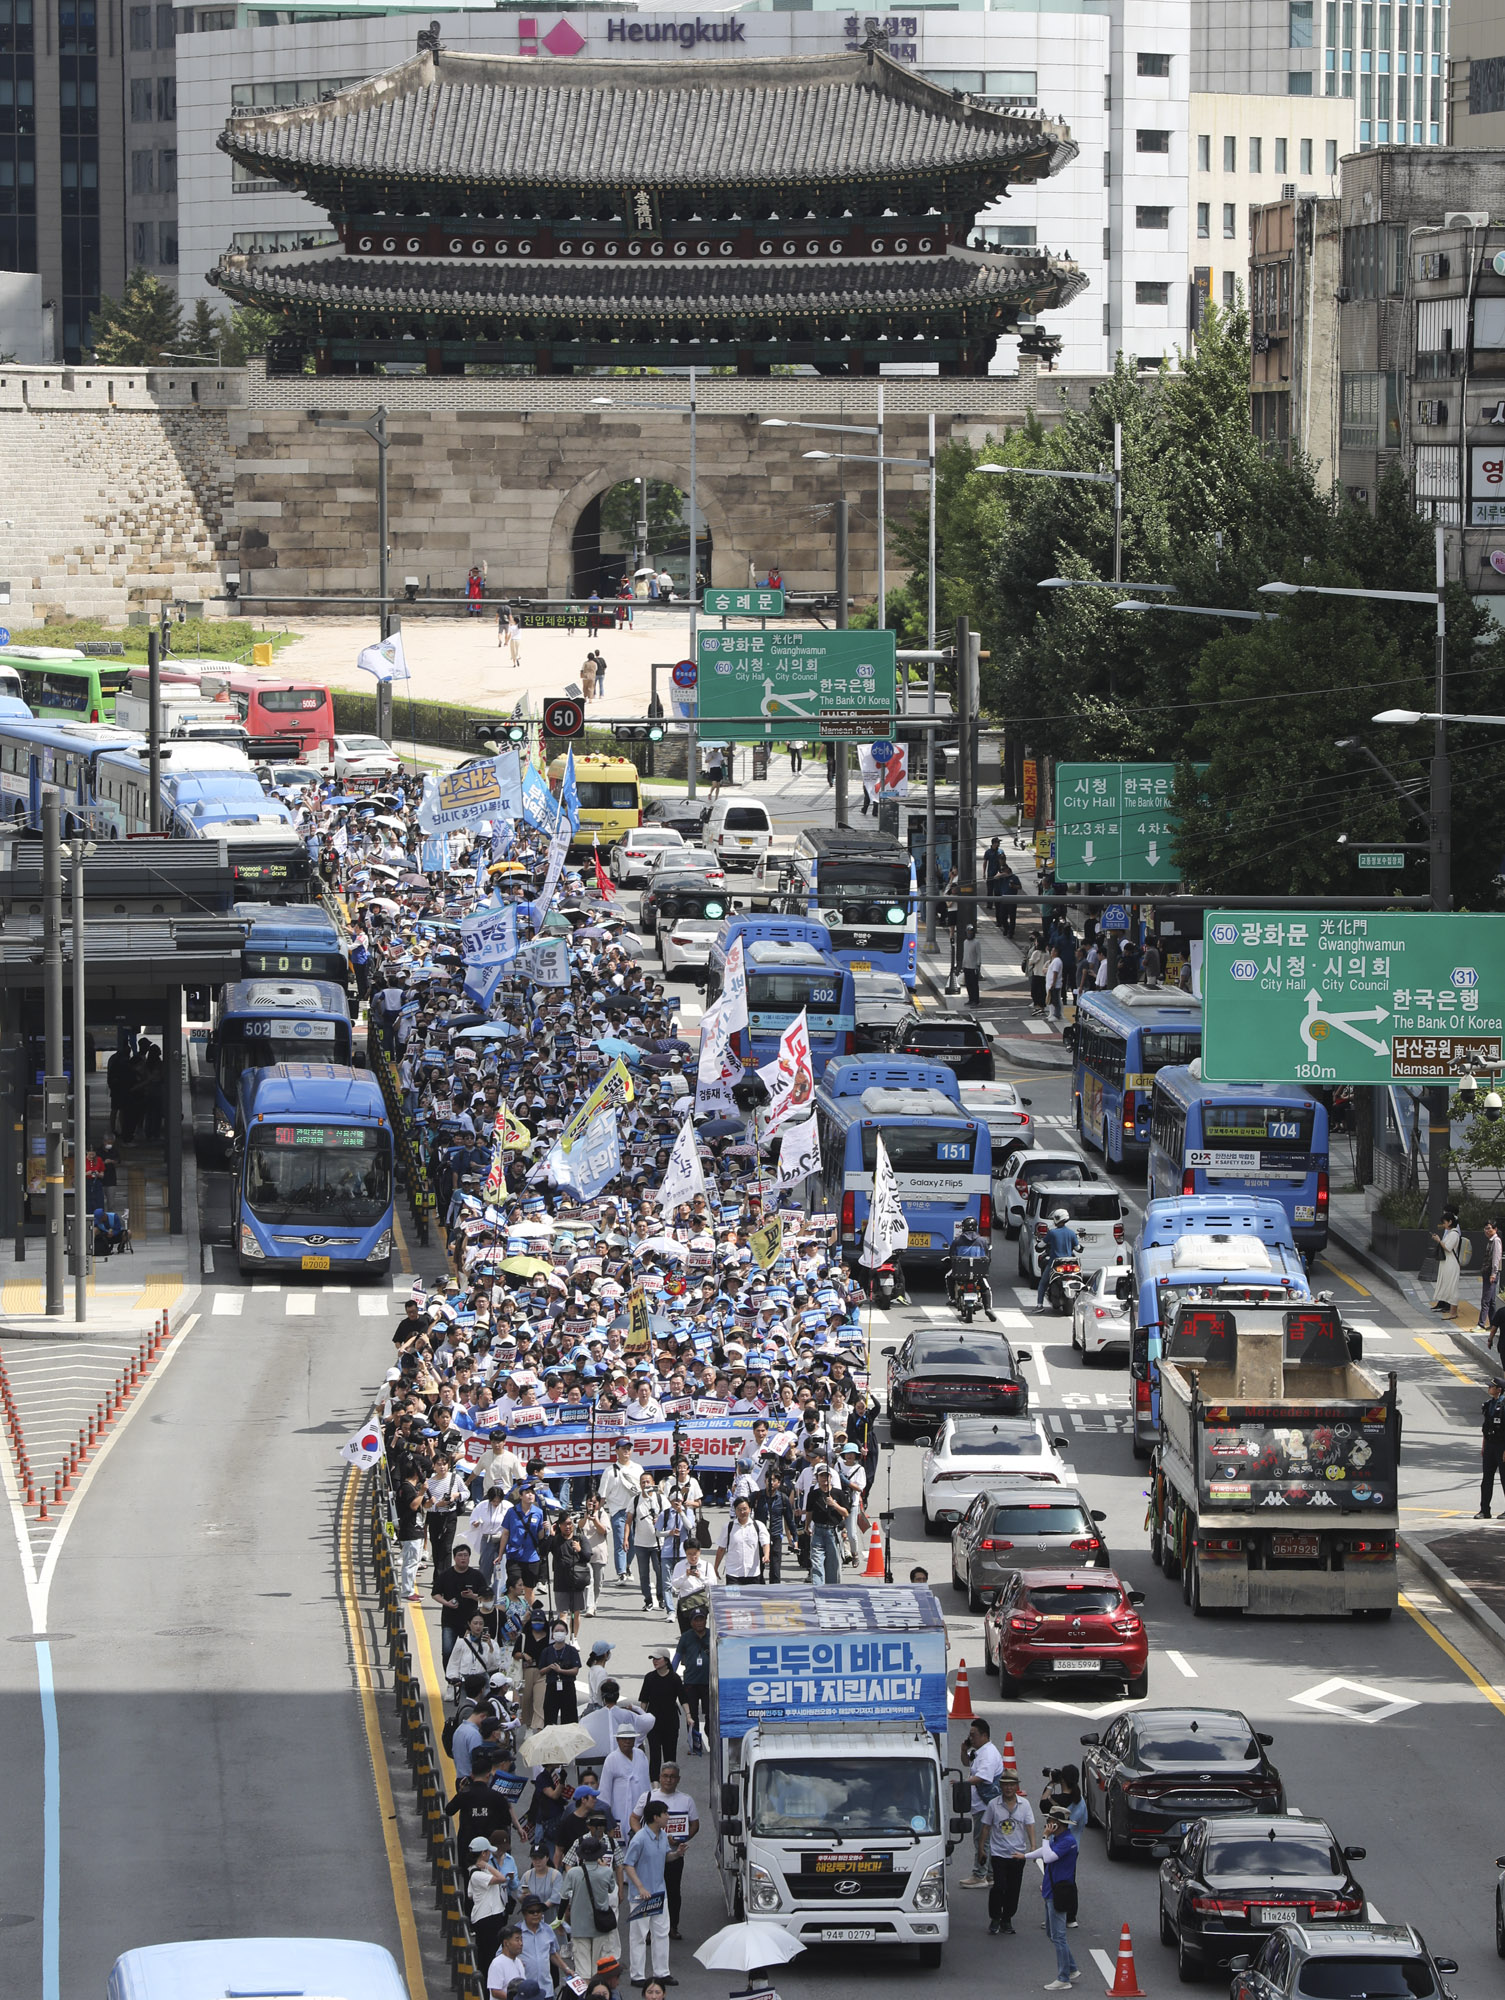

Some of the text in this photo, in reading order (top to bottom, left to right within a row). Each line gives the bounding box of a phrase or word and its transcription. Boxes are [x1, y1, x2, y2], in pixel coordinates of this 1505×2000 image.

[607, 17, 746, 48] Heungkuk
[715, 594, 773, 611] 숭례문
[523, 615, 588, 628] 진입제한차량
[705, 636, 765, 653] 50 광화문
[772, 634, 803, 646] 光化門
[771, 646, 827, 657] Gwanghwamun
[718, 658, 818, 673] 60 시청 시의회
[858, 666, 872, 677] 31
[735, 672, 765, 682] City Hall
[775, 672, 818, 682] City Council
[820, 678, 876, 693] 한국은행
[302, 700, 317, 708] 5005
[820, 696, 890, 705] The Bank Of Korea
[553, 710, 574, 727] 50
[1074, 778, 1107, 794] 시청
[1064, 797, 1116, 810] City Hall
[1124, 797, 1137, 808] The
[1137, 797, 1154, 808] Bank
[1155, 797, 1164, 808] Of
[1216, 922, 1309, 947] 50 광화문
[1320, 919, 1368, 936] 光化門
[1318, 937, 1406, 954] Gwanghwamun
[259, 956, 312, 971] 100
[1236, 955, 1391, 978] 60 시청 시의회
[1456, 970, 1473, 984] 31
[1260, 979, 1306, 992] City Hall
[1322, 979, 1389, 992] City Council
[812, 989, 834, 1002] 502
[1392, 988, 1479, 1011] 한국은행
[245, 1023, 270, 1036] 502
[1393, 1015, 1502, 1030] The Bank Of Korea
[192, 1029, 206, 1037] 502
[1394, 1039, 1450, 1059] 남산공원
[1294, 1064, 1337, 1078] 180m
[1394, 1064, 1444, 1076] Namsan
[276, 1127, 294, 1144] 501
[1271, 1123, 1297, 1137] 704
[942, 1144, 966, 1159] 151
[910, 1178, 963, 1188] Galaxy Z Flip5
[514, 1413, 542, 1424] 투기철회
[710, 1419, 732, 1428] 바다,
[633, 1438, 669, 1456] 투기
[749, 1641, 922, 1675] 모두의 바다,
[747, 1678, 922, 1704] 우리가 지킵시다!
[748, 1709, 784, 1717] 더불어민주당
[815, 1861, 856, 1873] 해양투기
[857, 1861, 882, 1872] 반대!
[848, 1930, 871, 1939] 0279
